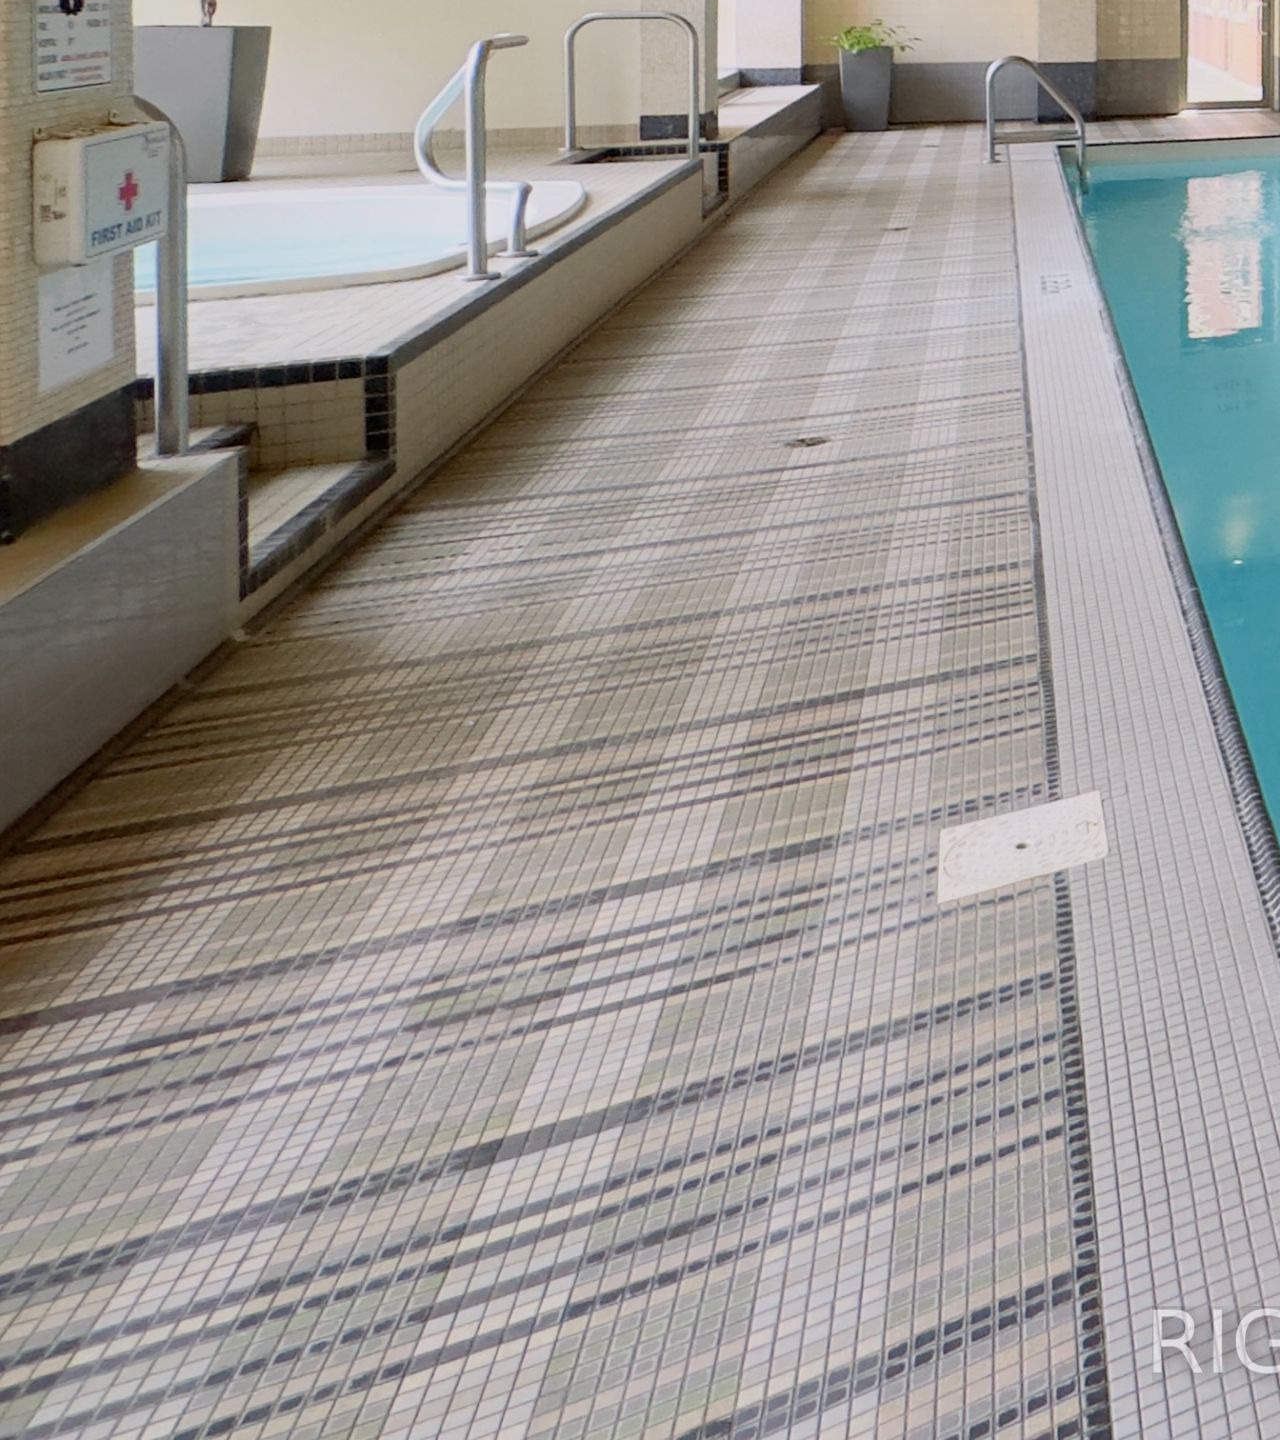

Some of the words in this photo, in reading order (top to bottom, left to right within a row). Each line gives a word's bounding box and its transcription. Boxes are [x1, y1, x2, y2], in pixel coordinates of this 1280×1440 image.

[91, 223, 122, 247] FIRST
[126, 217, 143, 235] AID
[145, 210, 162, 228] KIT
